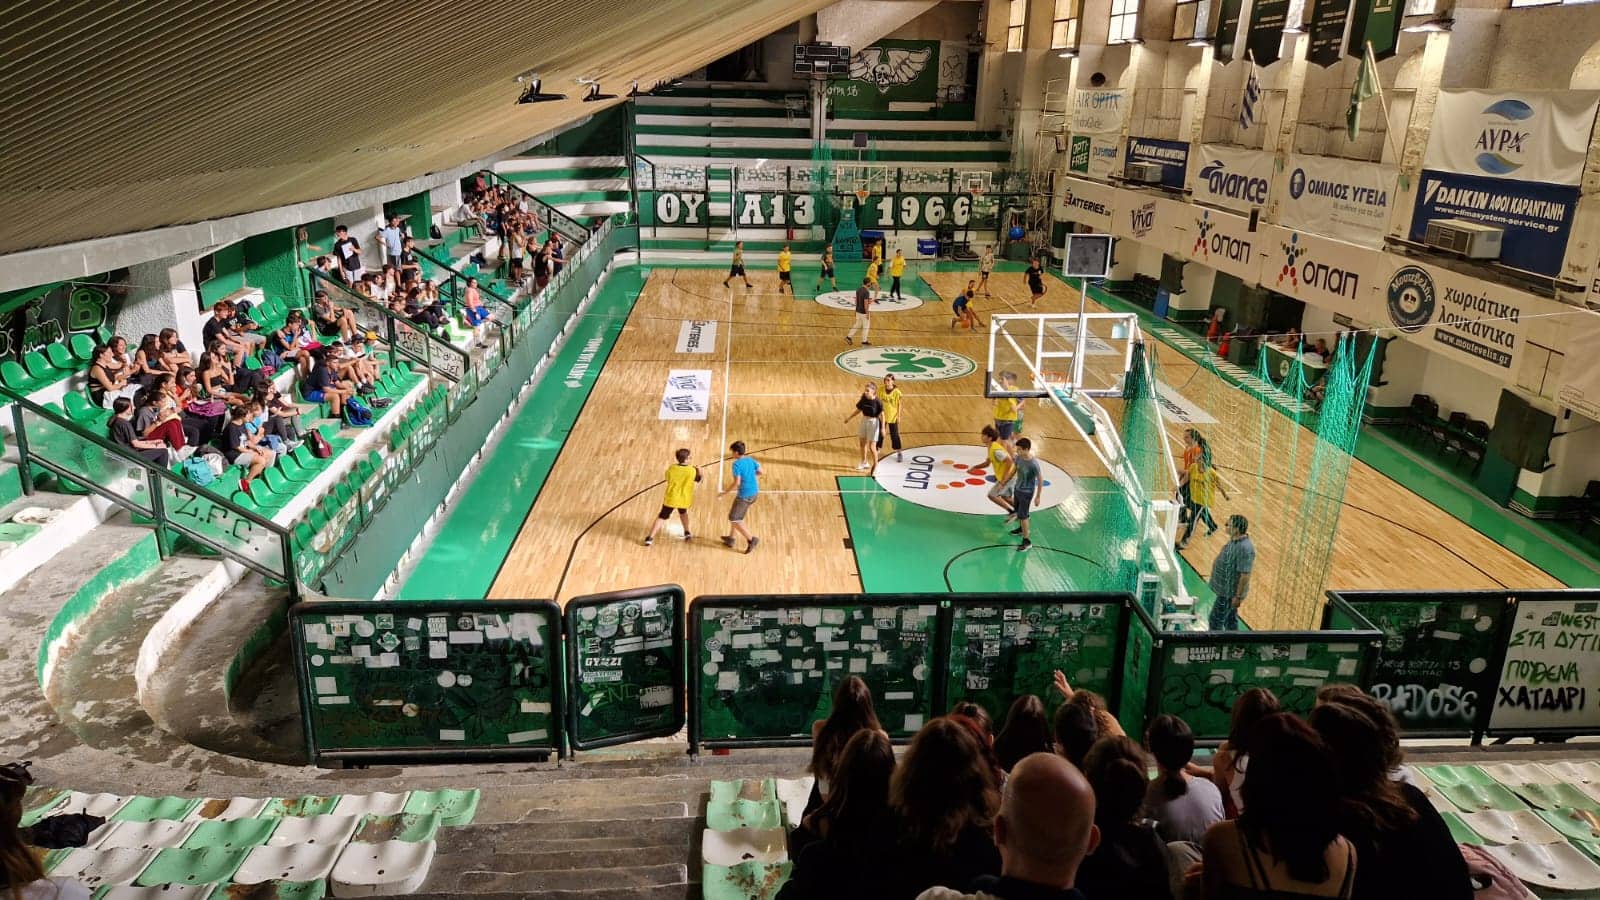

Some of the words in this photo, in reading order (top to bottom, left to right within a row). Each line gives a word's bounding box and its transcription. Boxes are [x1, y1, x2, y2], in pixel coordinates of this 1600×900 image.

[1208, 169, 1268, 204] avance
[1308, 179, 1350, 200] ΟΜΙΛΟΣ
[1352, 186, 1387, 207] ΥΓΕΙΑ
[1437, 186, 1490, 209] DAIKIN
[1510, 196, 1565, 221] ΚΑΡΑΝΤΑΝΗ
[877, 196, 970, 227] 1966
[1444, 287, 1520, 324] χωριάτικα
[1438, 305, 1515, 350] λουκάνικα
[1437, 331, 1510, 366] www.moutevelis.gr
[1509, 629, 1545, 650] ΣΤΑ
[1554, 631, 1600, 652] ΔΥΤΙ
